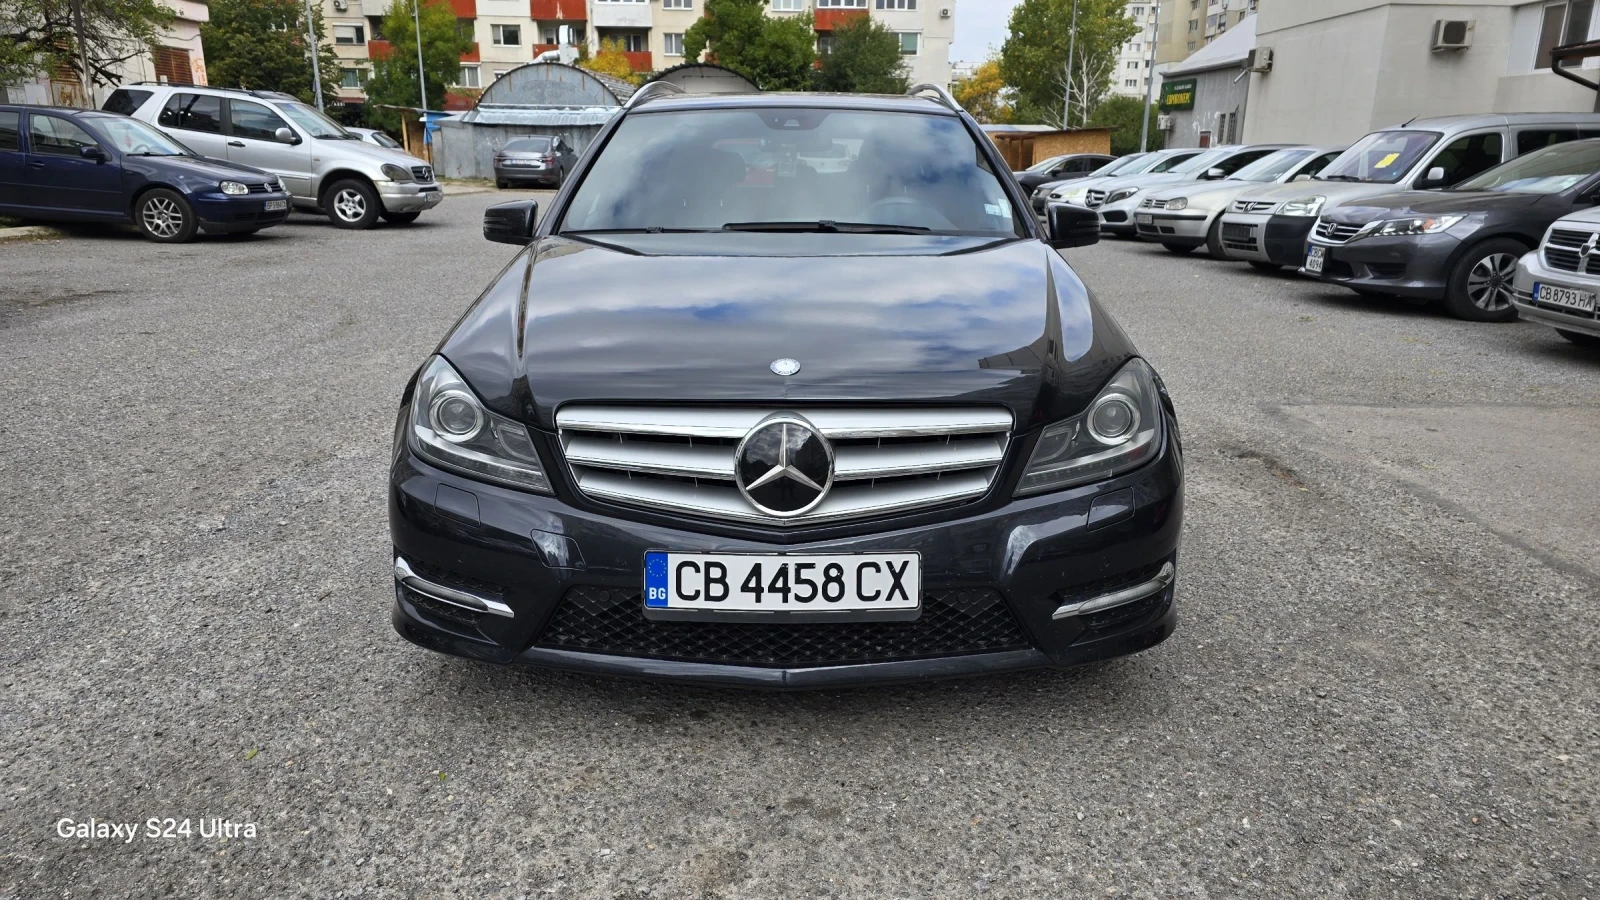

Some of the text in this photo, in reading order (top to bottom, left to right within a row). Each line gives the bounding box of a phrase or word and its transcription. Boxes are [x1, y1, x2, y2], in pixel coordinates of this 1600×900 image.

[1540, 286, 1552, 300] CB
[1553, 289, 1577, 305] 8793
[675, 560, 910, 604] CB 4458 CX
[649, 587, 666, 600] BG
